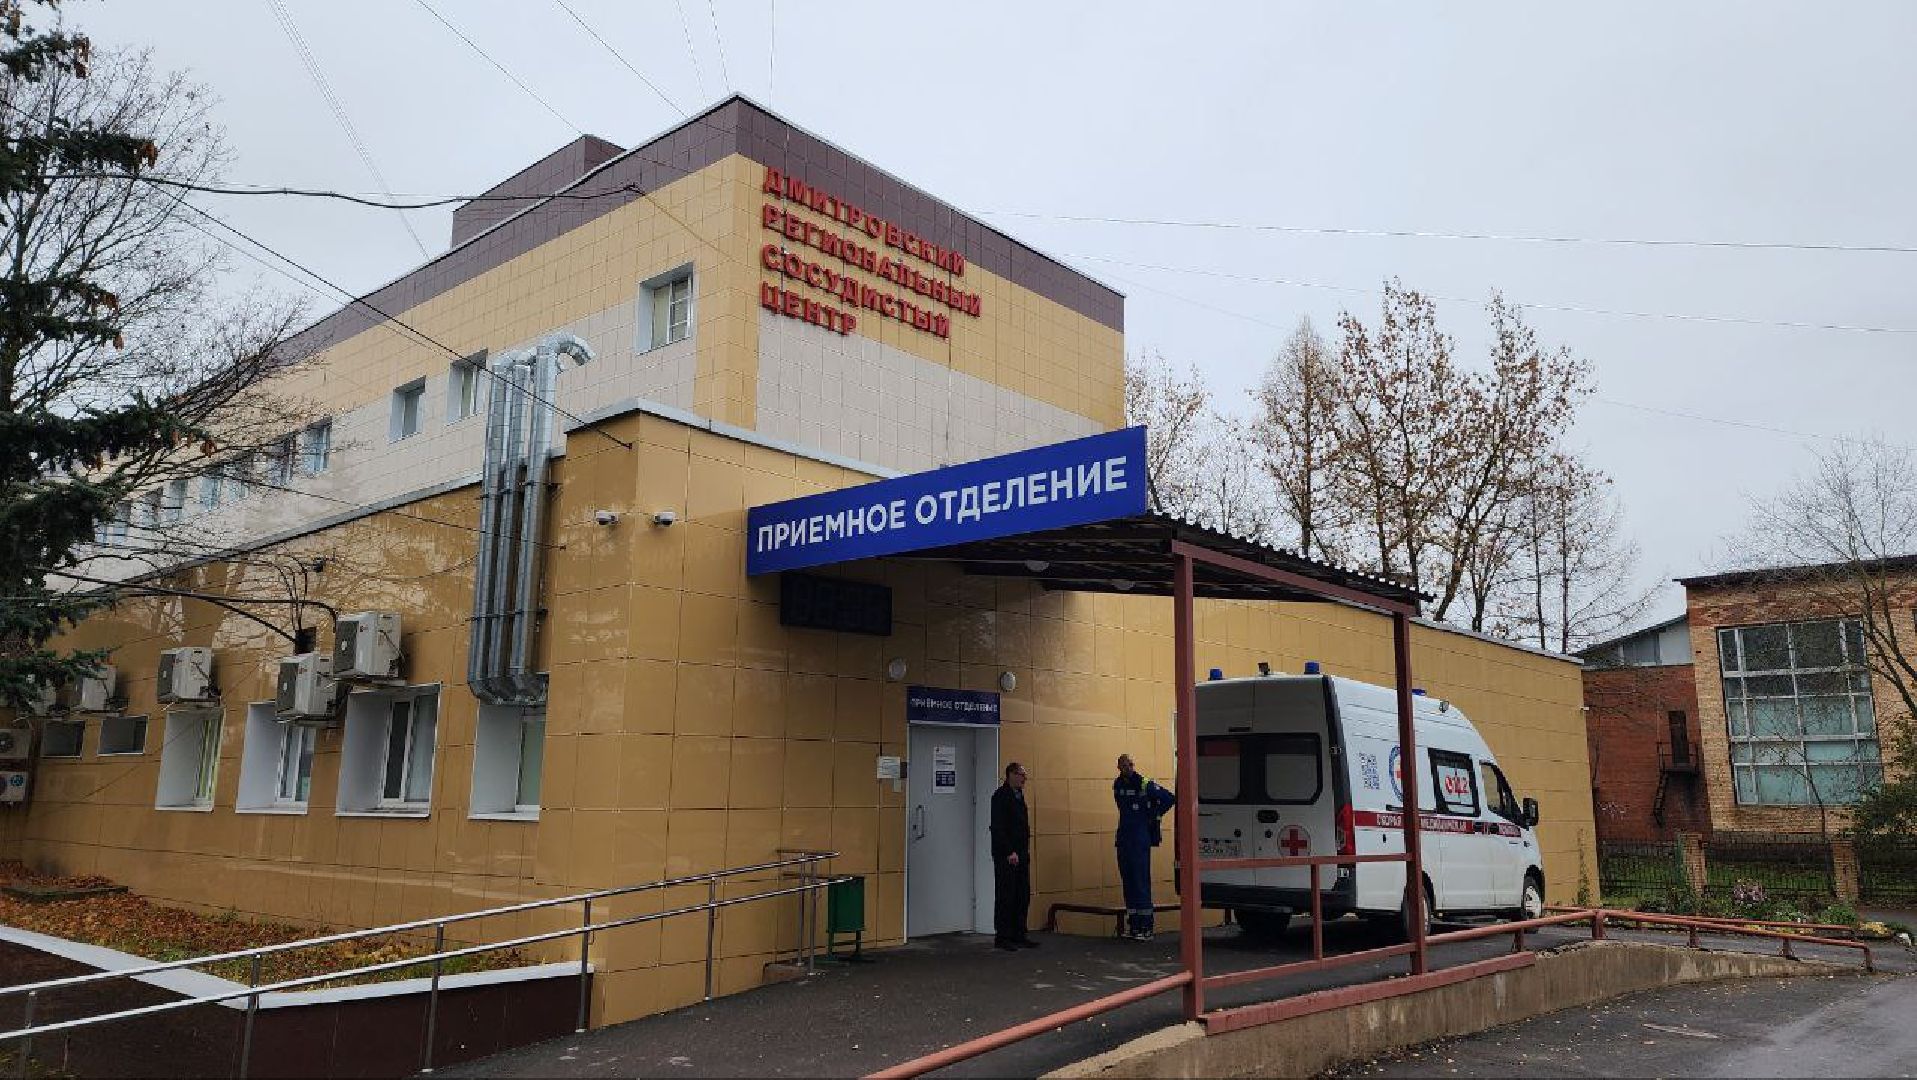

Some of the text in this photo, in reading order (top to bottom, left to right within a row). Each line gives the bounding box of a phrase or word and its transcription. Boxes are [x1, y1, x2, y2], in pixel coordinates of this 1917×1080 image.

[763, 166, 966, 277] ДМИТРОВСКИЙ
[763, 203, 982, 318] РЕГИОНАЛЬНЫЙ
[761, 281, 857, 336] ЦЕНТР
[762, 244, 949, 338] СОСУДИСТЫЙ
[757, 456, 1128, 553] ПРИЕМНОЕ ОТДЕЛЕНИЕ
[954, 701, 998, 712] ОТДЕЛЕНИЕ
